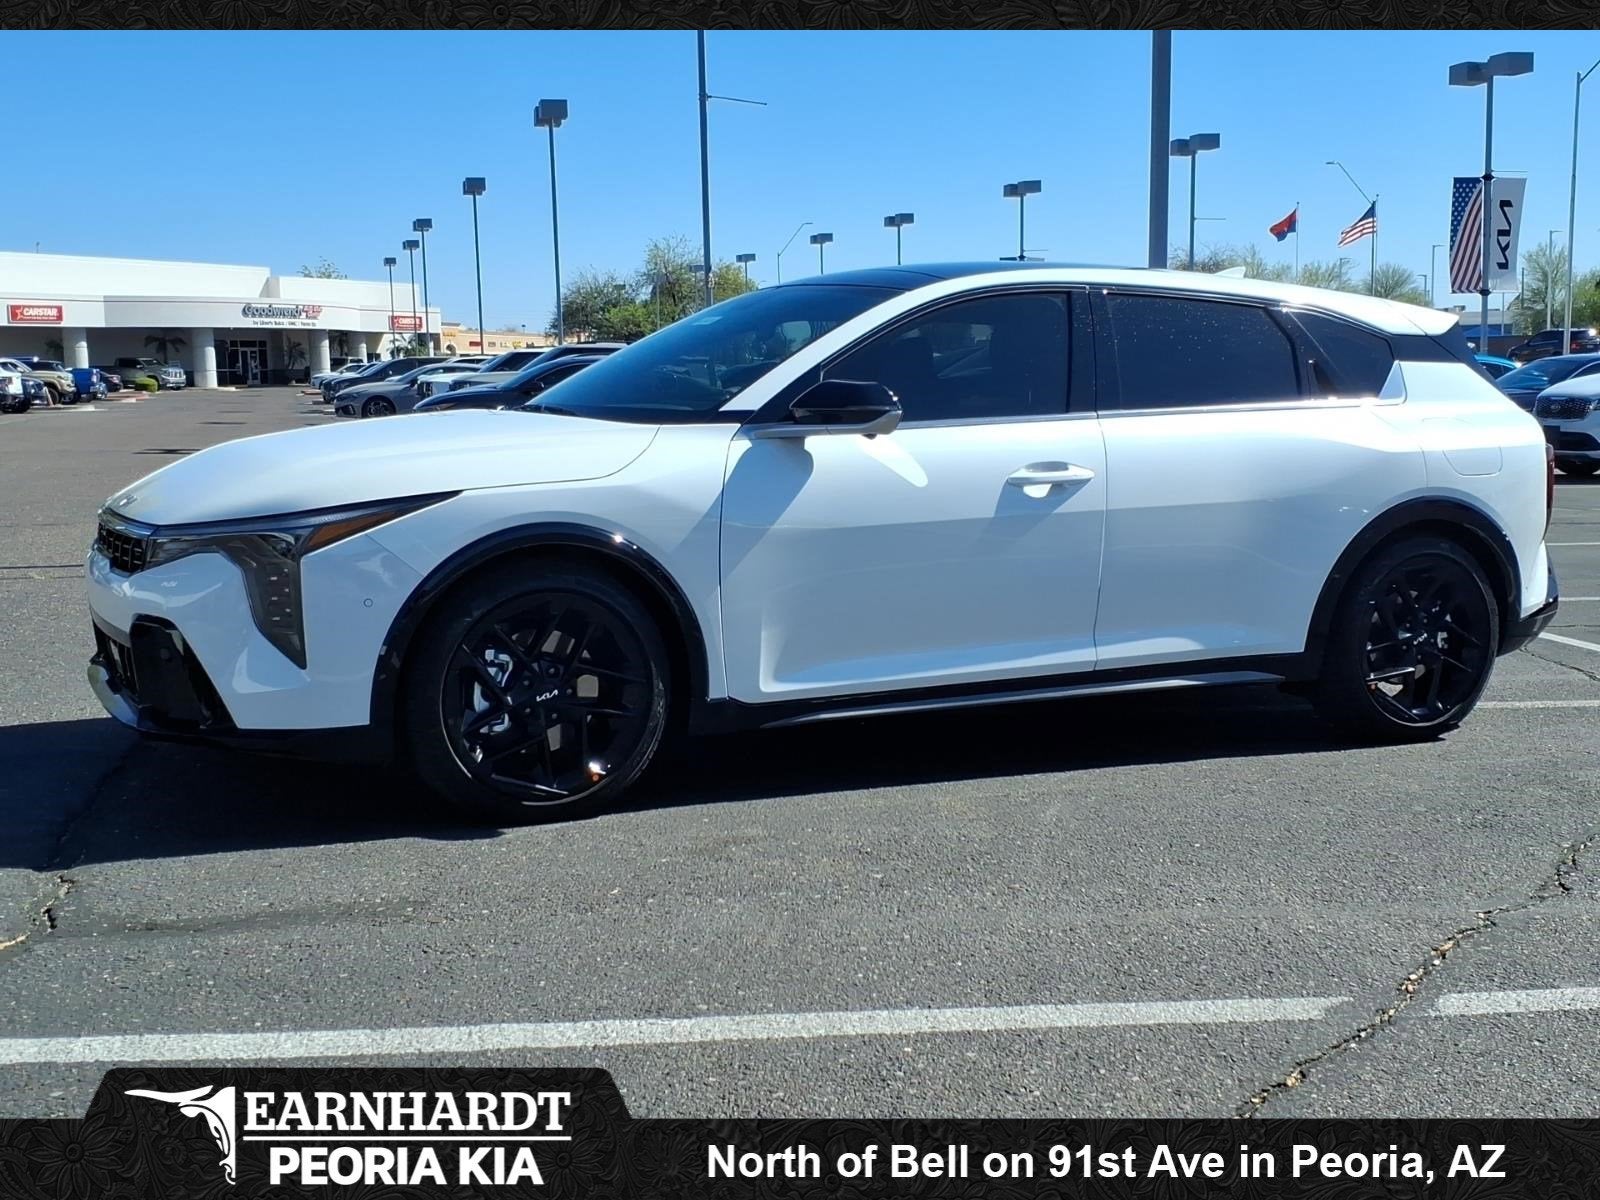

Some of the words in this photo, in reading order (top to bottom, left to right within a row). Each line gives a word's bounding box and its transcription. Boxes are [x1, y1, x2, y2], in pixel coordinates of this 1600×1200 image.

[1496, 199, 1514, 270] KIA
[23, 307, 58, 316] CARSTAR
[535, 688, 559, 702] KIA
